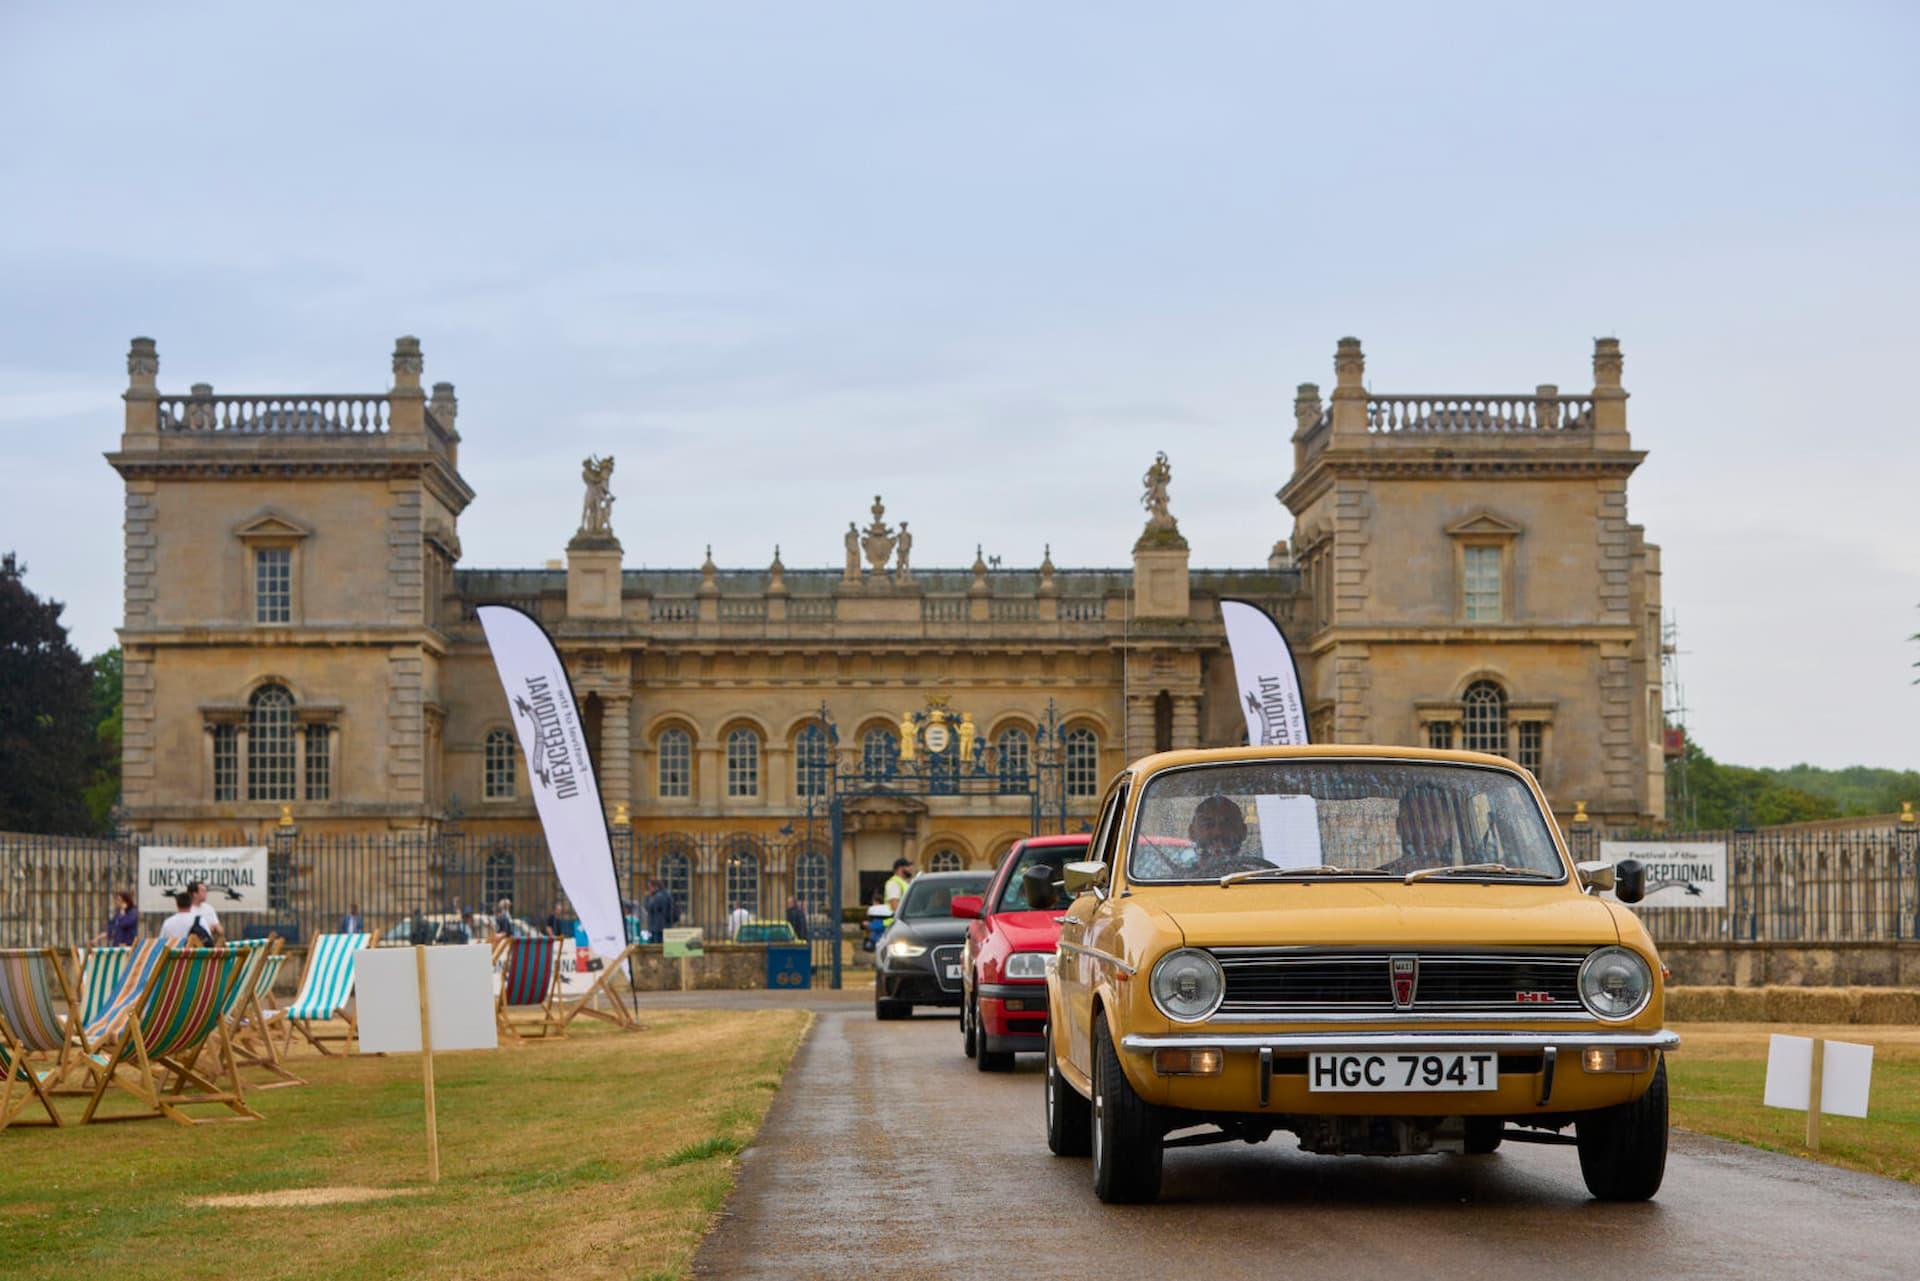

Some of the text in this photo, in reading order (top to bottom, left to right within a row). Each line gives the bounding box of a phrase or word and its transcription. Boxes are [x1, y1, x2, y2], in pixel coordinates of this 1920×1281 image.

[167, 855, 239, 864] Festival of the
[1629, 851, 1698, 859] Festival of the
[149, 867, 256, 887] UNEXCEPTIONAL
[1645, 863, 1715, 882] CEPTIONAL
[1516, 991, 1555, 1004] HL
[1314, 1055, 1492, 1087] HGC 794T
